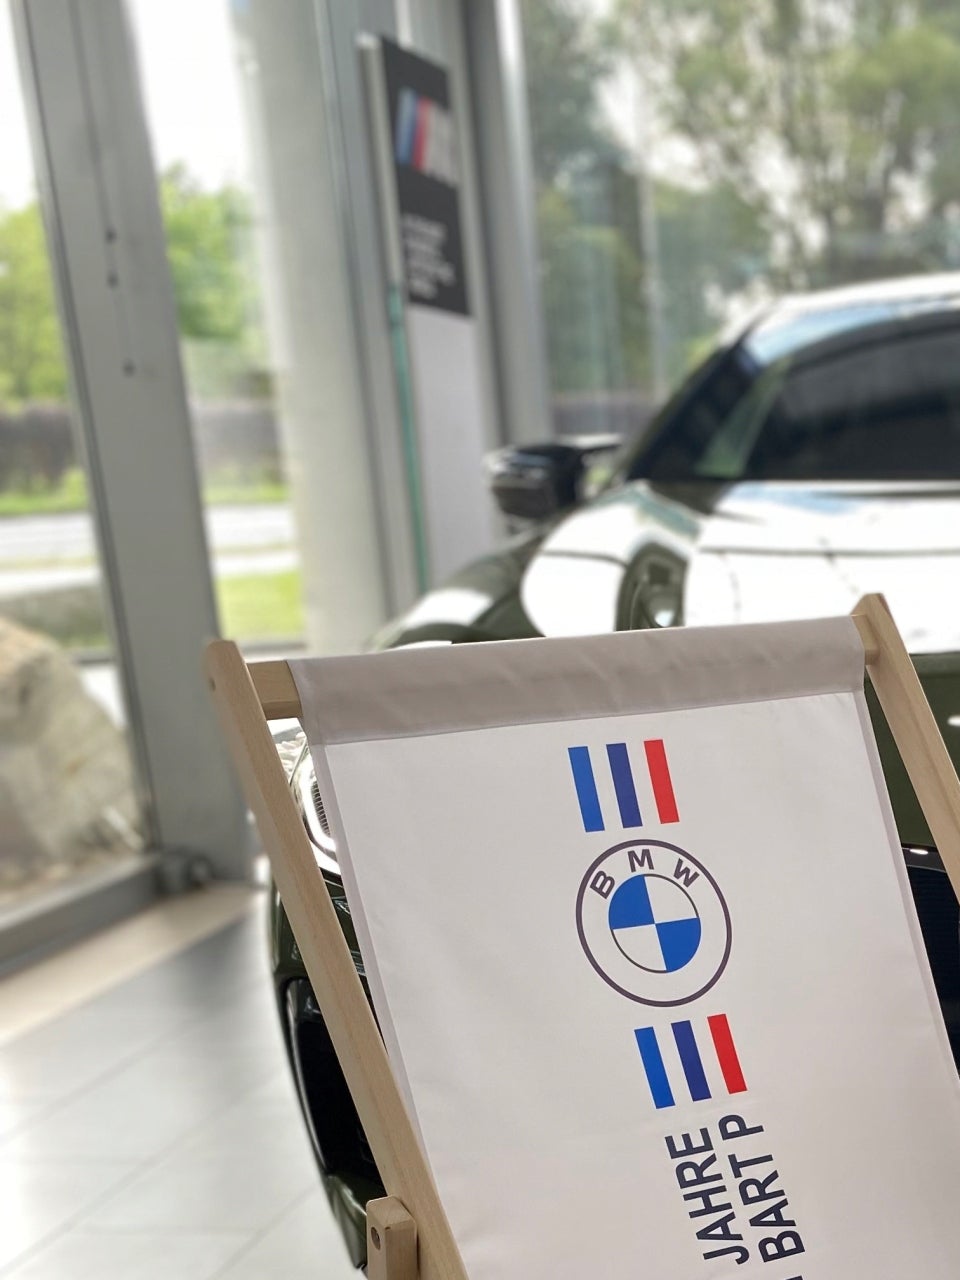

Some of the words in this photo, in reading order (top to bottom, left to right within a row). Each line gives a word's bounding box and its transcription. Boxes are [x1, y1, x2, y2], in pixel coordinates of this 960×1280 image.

[589, 848, 700, 900] BMW
[717, 1113, 764, 1141] P
[664, 1127, 751, 1265] JAHRE
[727, 1153, 806, 1263] BART
